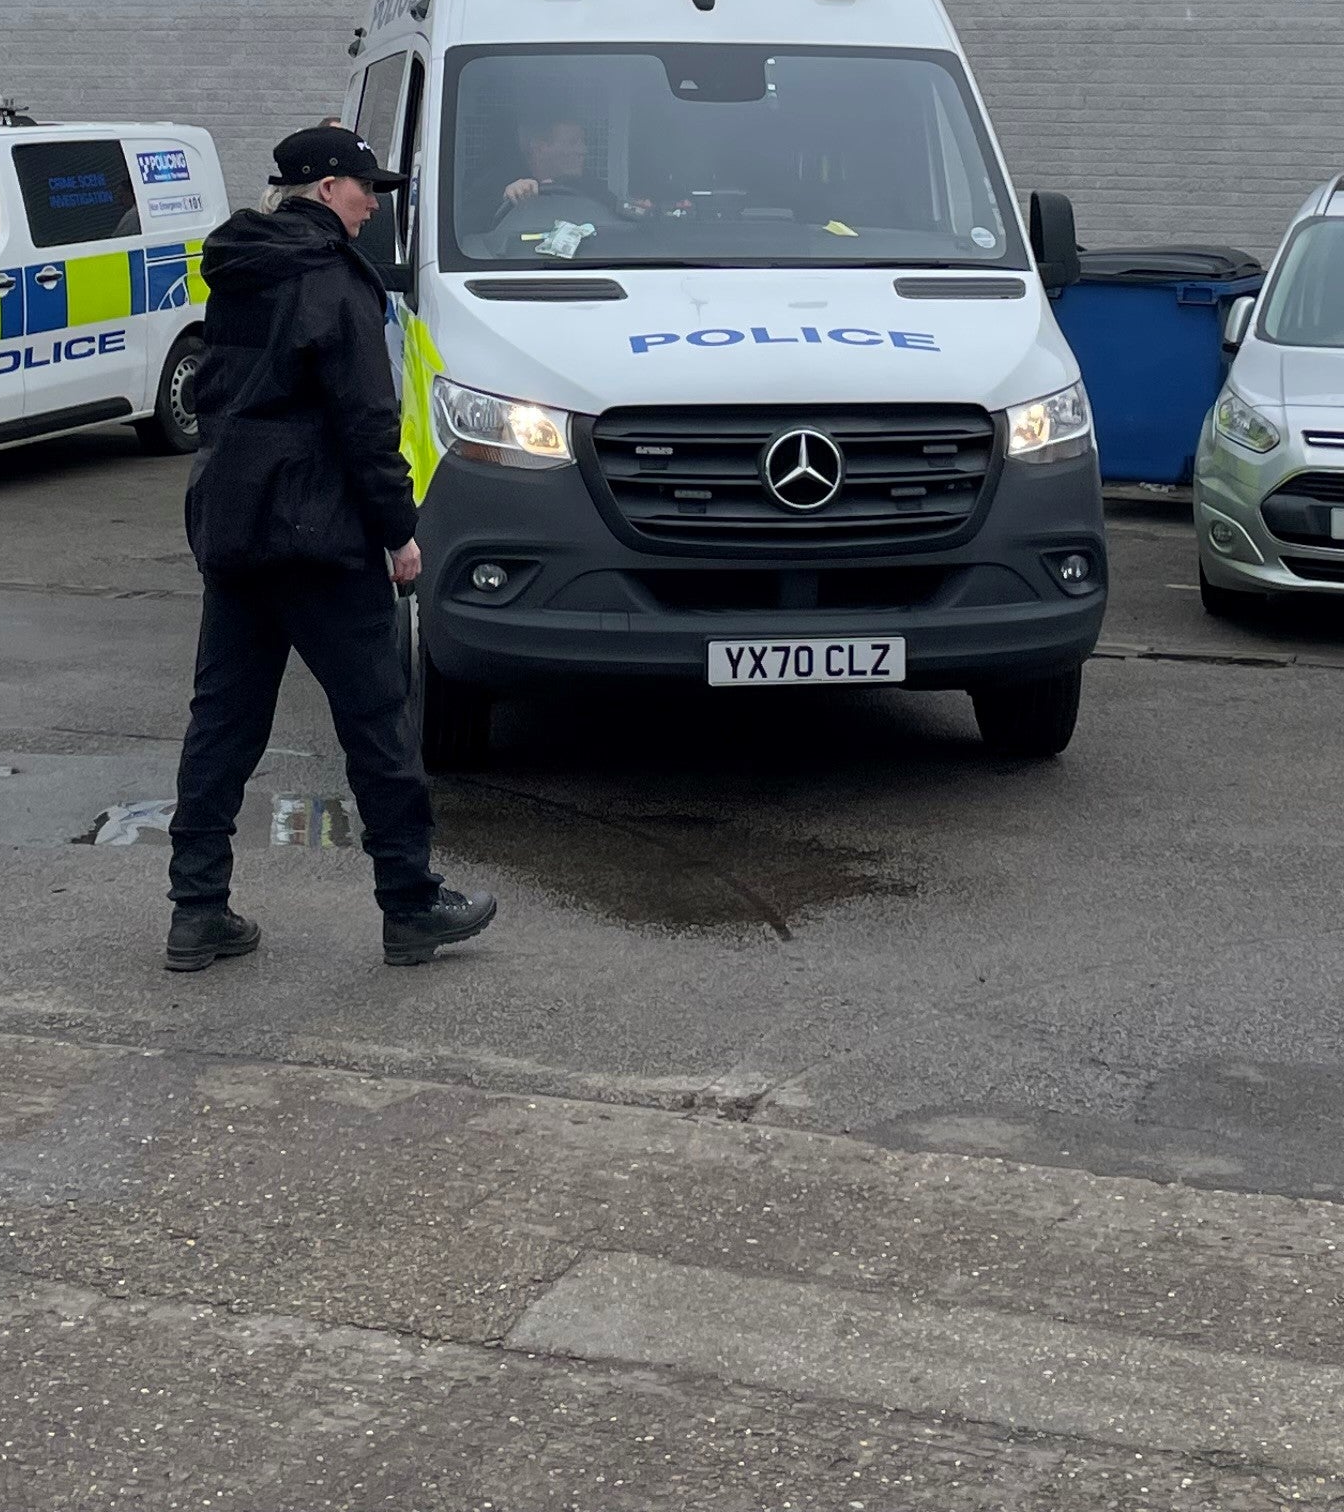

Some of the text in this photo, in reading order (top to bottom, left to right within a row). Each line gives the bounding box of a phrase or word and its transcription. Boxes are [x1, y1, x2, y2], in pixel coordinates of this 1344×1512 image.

[628, 326, 942, 354] POLICE
[725, 644, 891, 679] YX70 CLZ
